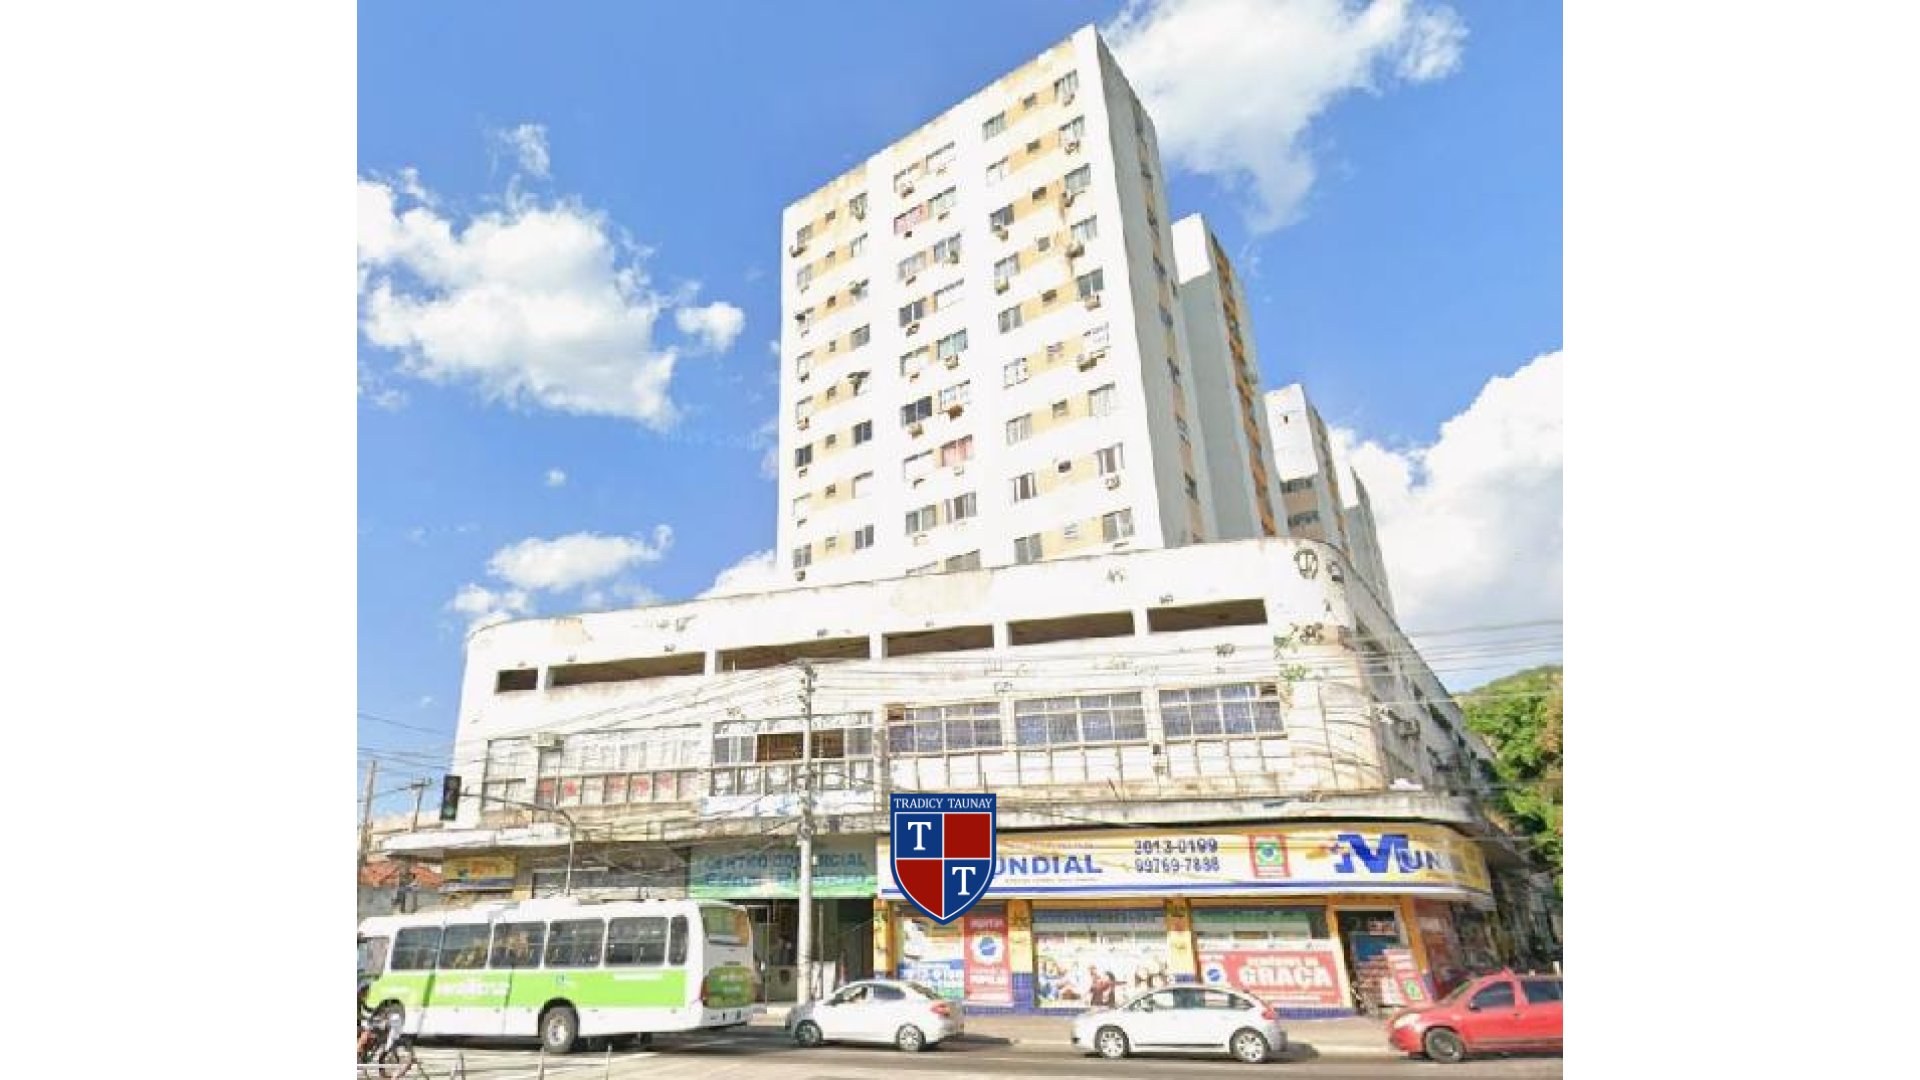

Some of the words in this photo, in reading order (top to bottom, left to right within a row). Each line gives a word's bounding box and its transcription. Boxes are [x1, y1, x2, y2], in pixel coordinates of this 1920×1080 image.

[773, 852, 867, 868] CORCIAL
[994, 854, 1103, 876] UNDIAL
[1238, 963, 1334, 988] GRAÇA
